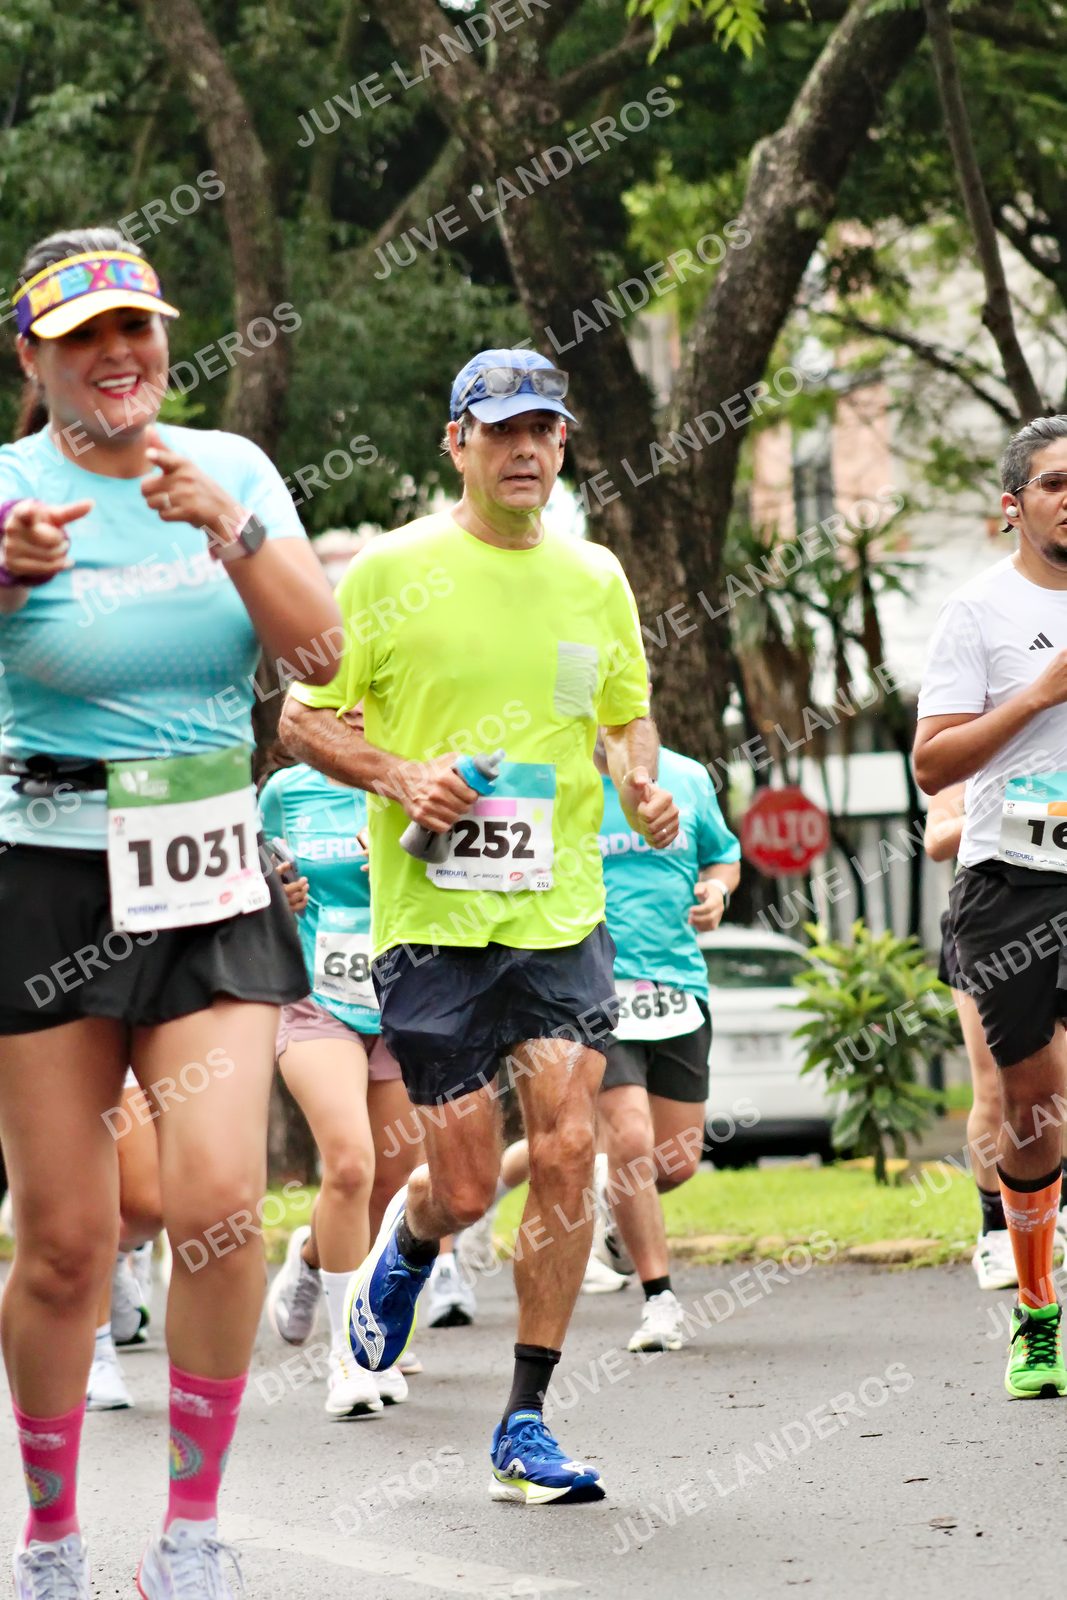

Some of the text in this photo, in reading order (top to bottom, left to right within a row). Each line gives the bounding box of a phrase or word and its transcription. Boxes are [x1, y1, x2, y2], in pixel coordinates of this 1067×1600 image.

[453, 819, 535, 859] 252
[751, 810, 823, 849] ALTO
[128, 823, 248, 888] 1031
[1005, 849, 1035, 862] PERDURA
